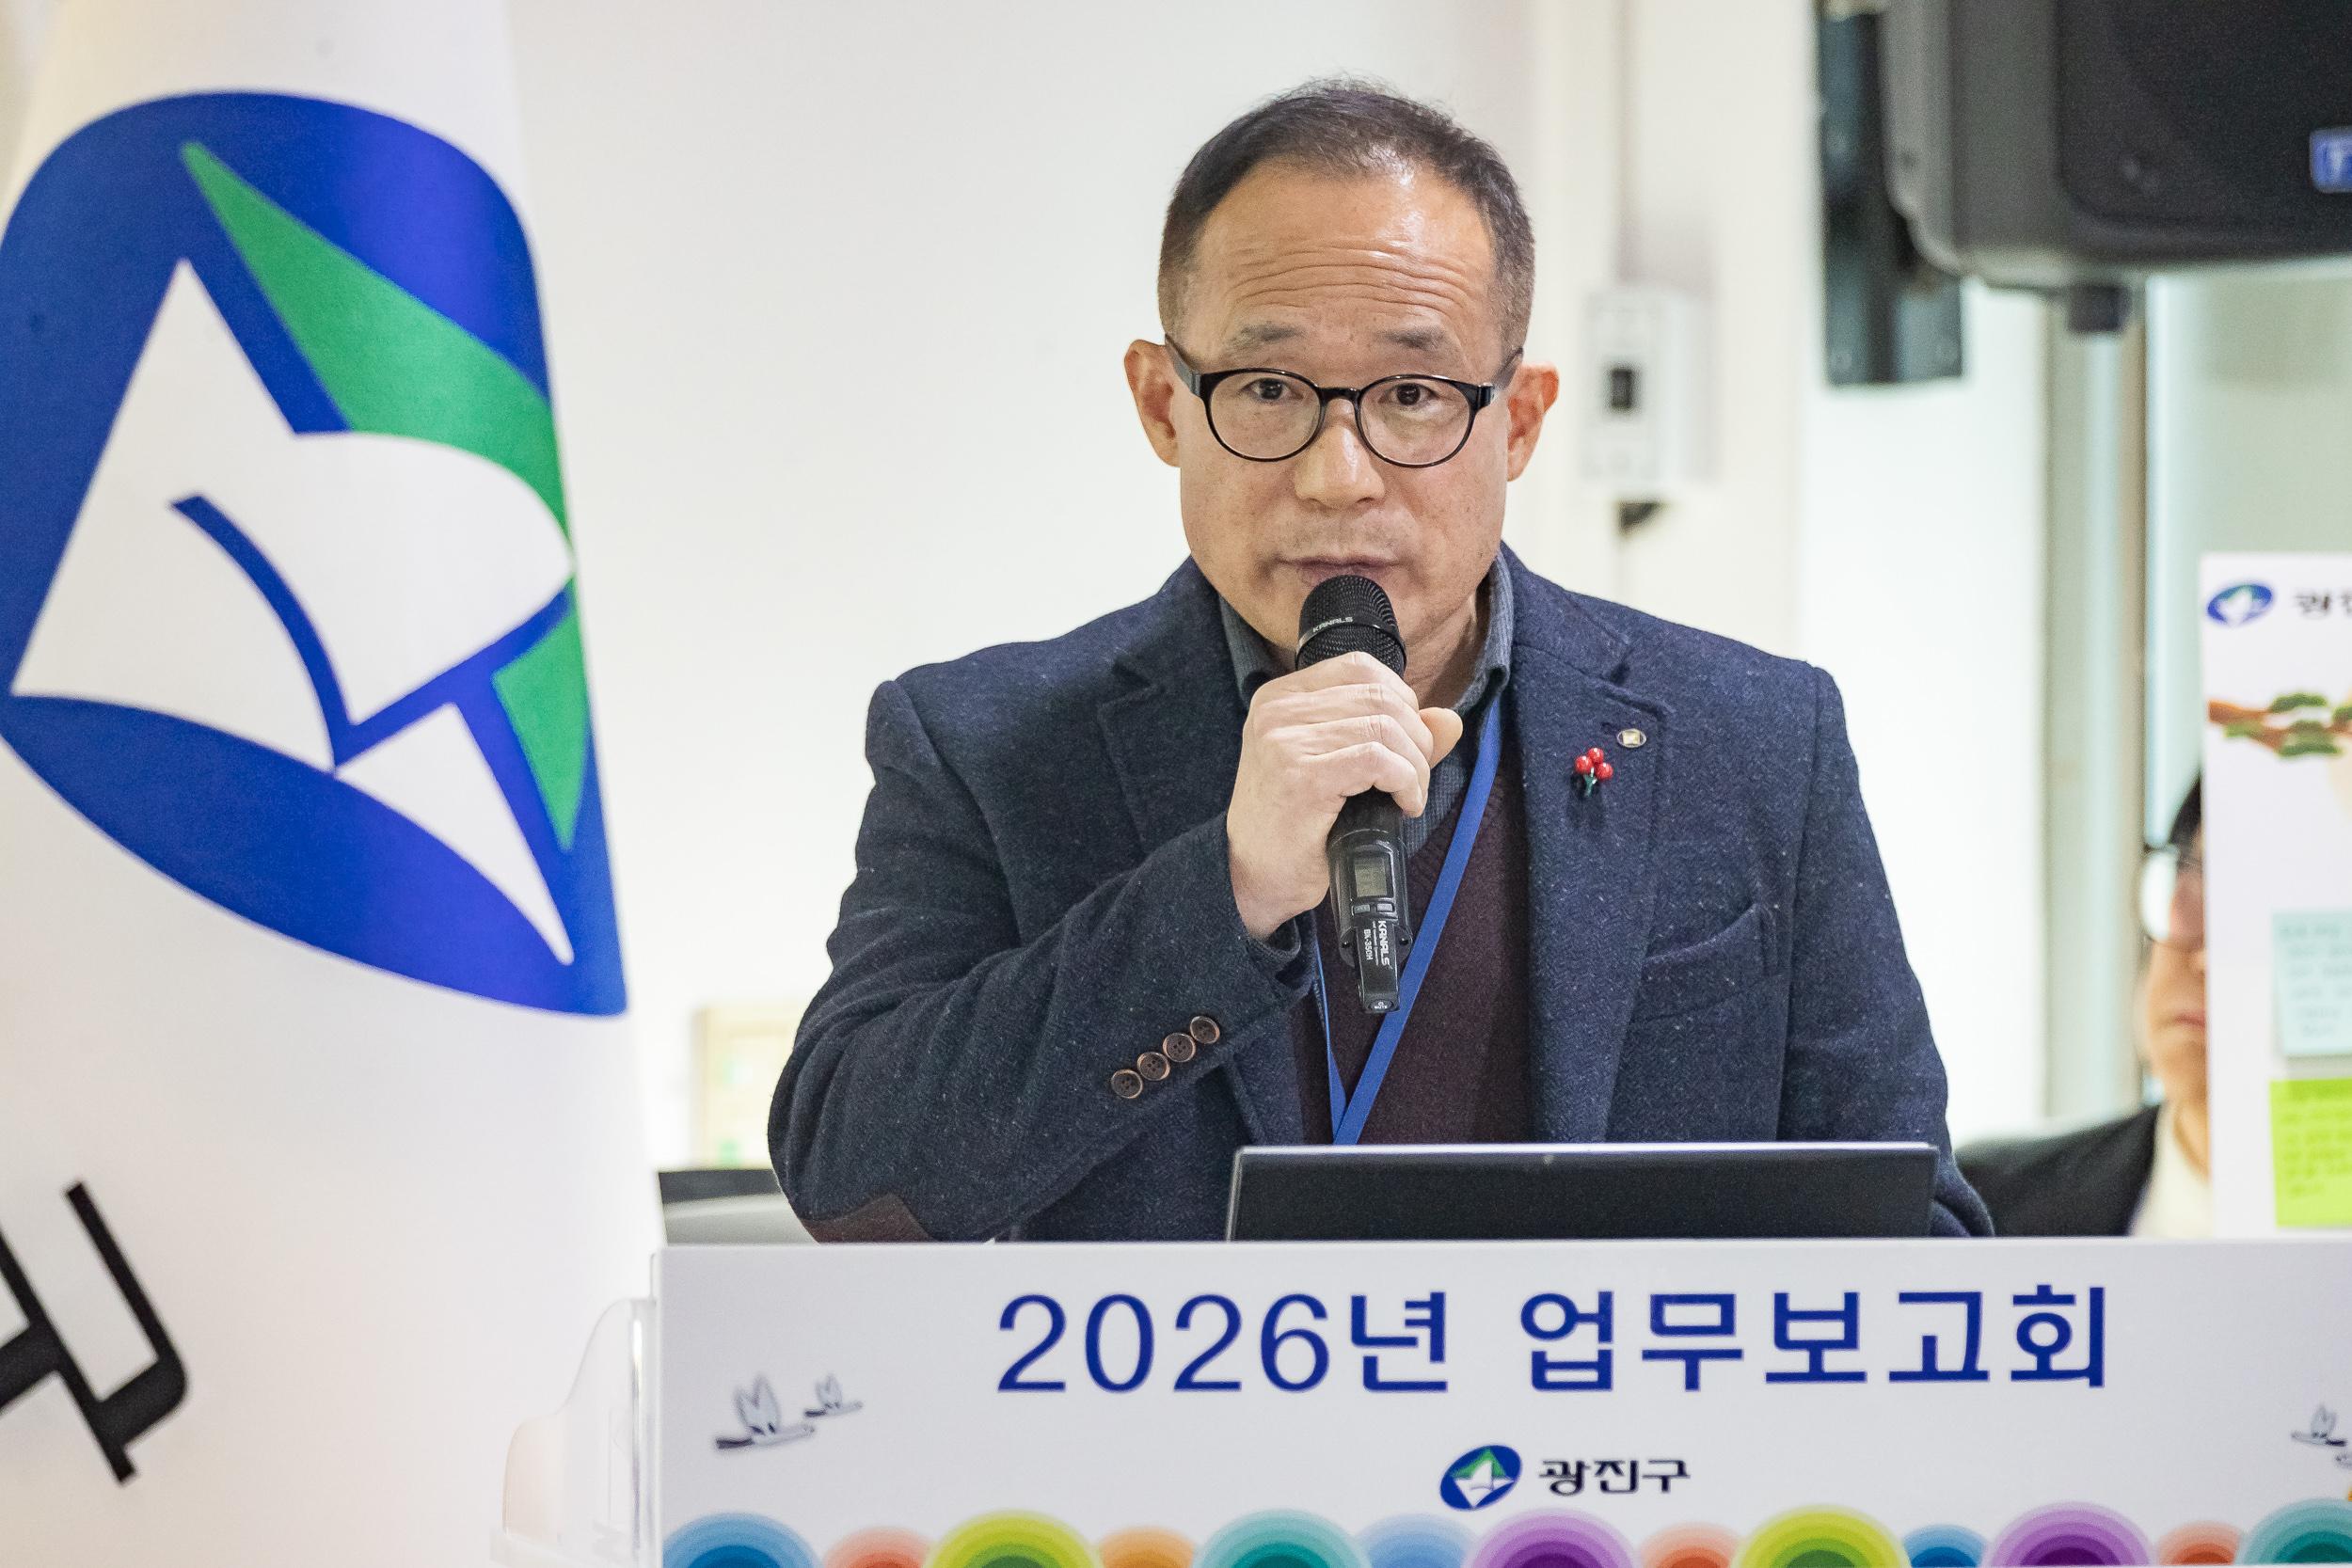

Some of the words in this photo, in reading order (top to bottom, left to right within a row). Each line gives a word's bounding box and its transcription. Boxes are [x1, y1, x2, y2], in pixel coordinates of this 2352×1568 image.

[1312, 616, 1353, 633] KANALS
[1377, 920, 1391, 967] KANALS
[996, 1291, 1450, 1394] 2026년
[1519, 1283, 2106, 1393] 업무보고회
[1538, 1458, 1692, 1497] 광진구
